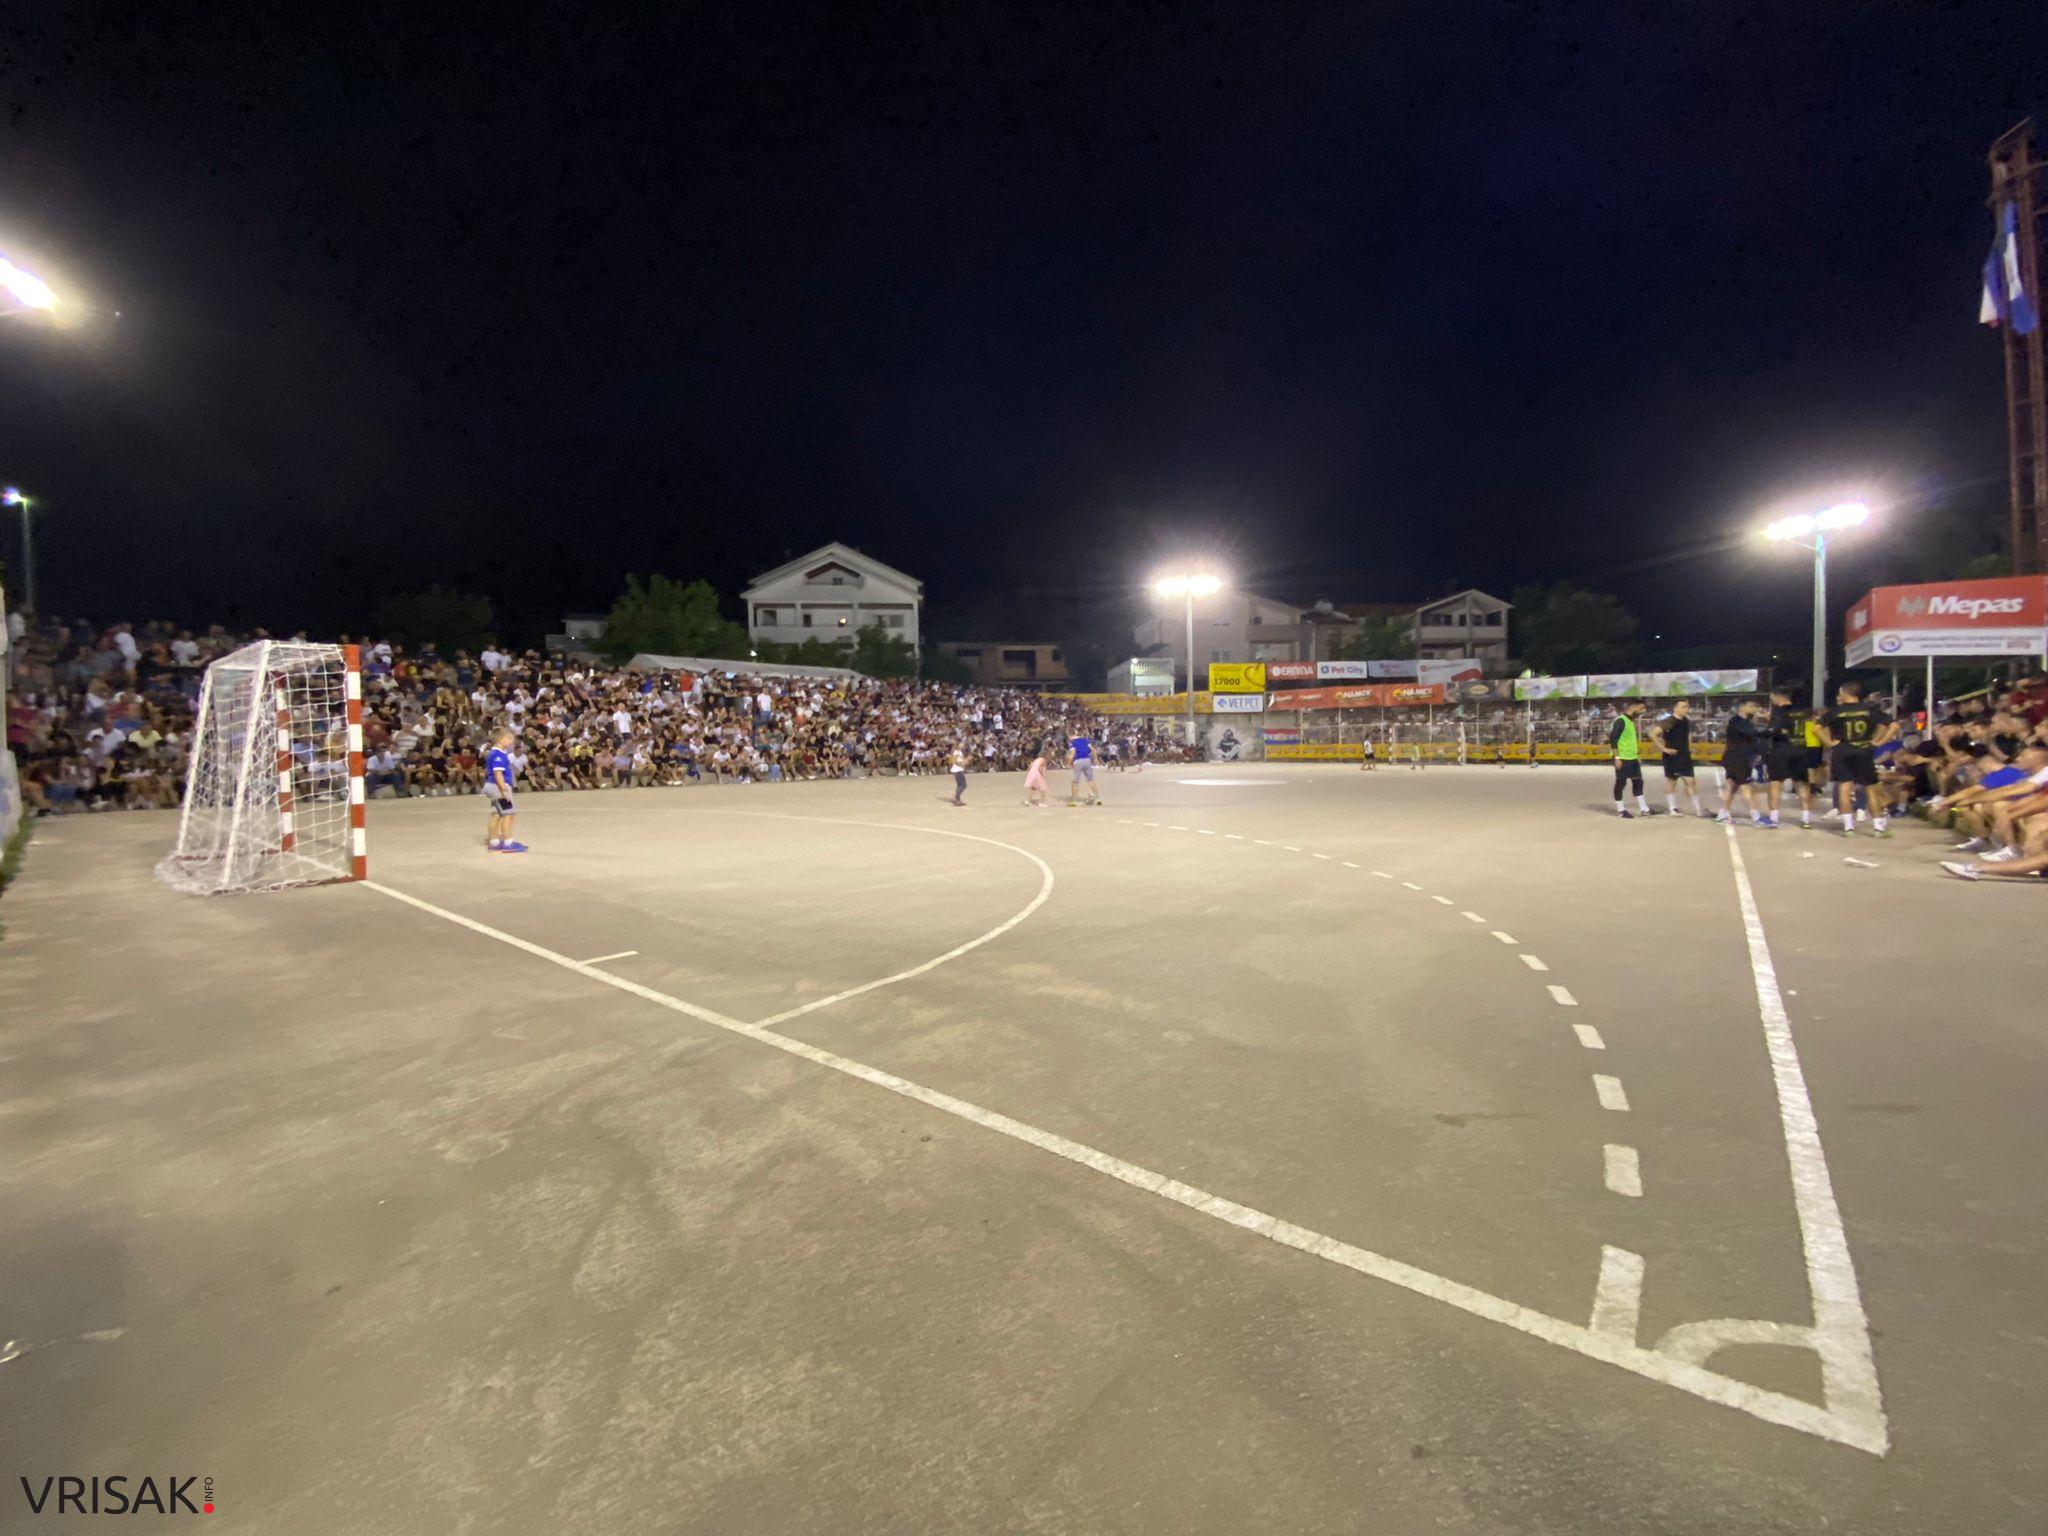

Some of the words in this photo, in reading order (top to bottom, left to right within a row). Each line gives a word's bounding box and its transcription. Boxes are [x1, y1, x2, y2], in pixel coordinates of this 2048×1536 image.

[1927, 595, 2024, 620] Mepas
[1331, 666, 1344, 674] Pet
[1347, 666, 1364, 675] City
[1214, 678, 1240, 686] 17000
